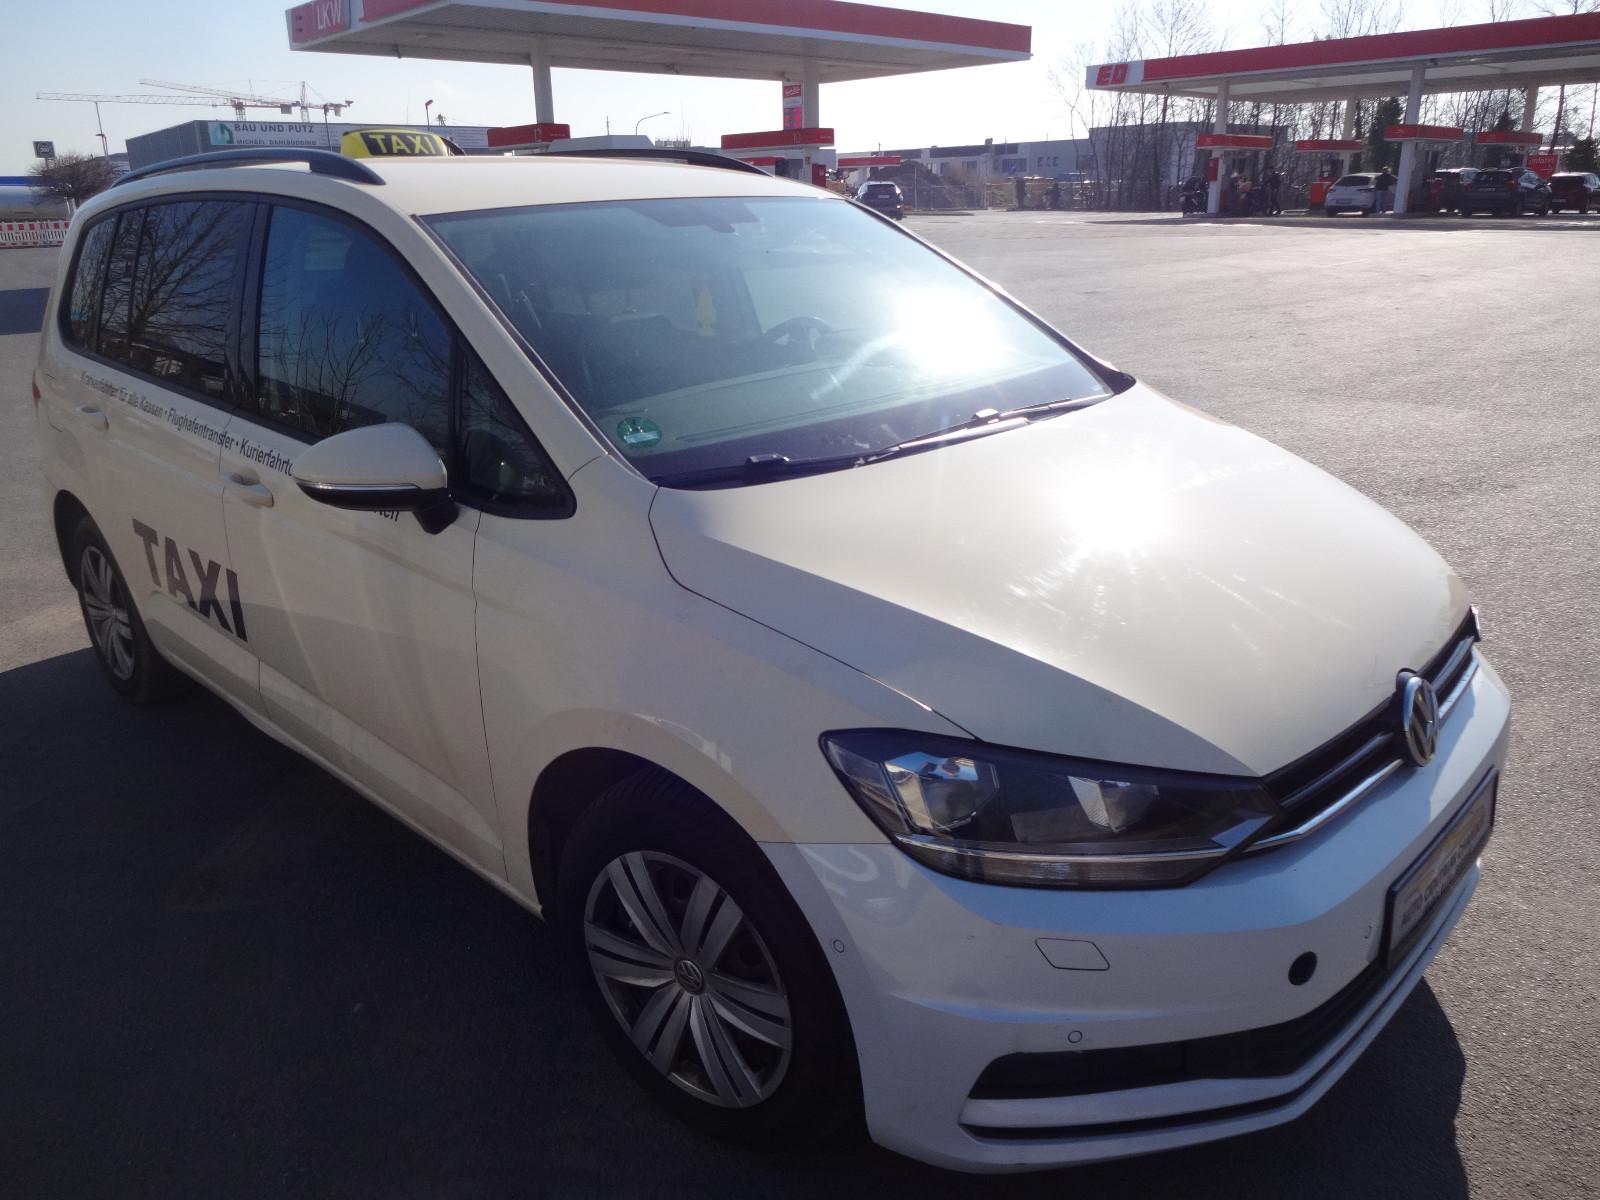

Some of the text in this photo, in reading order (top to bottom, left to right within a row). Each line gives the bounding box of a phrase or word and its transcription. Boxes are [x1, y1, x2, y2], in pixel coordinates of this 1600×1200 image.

[317, 0, 342, 31] LKW
[234, 123, 315, 133] BAU UND PUTZ
[368, 134, 437, 155] TAXI
[139, 395, 163, 419] Kassen
[167, 407, 235, 450] Flughafentransfer
[132, 518, 249, 643] TAXI
